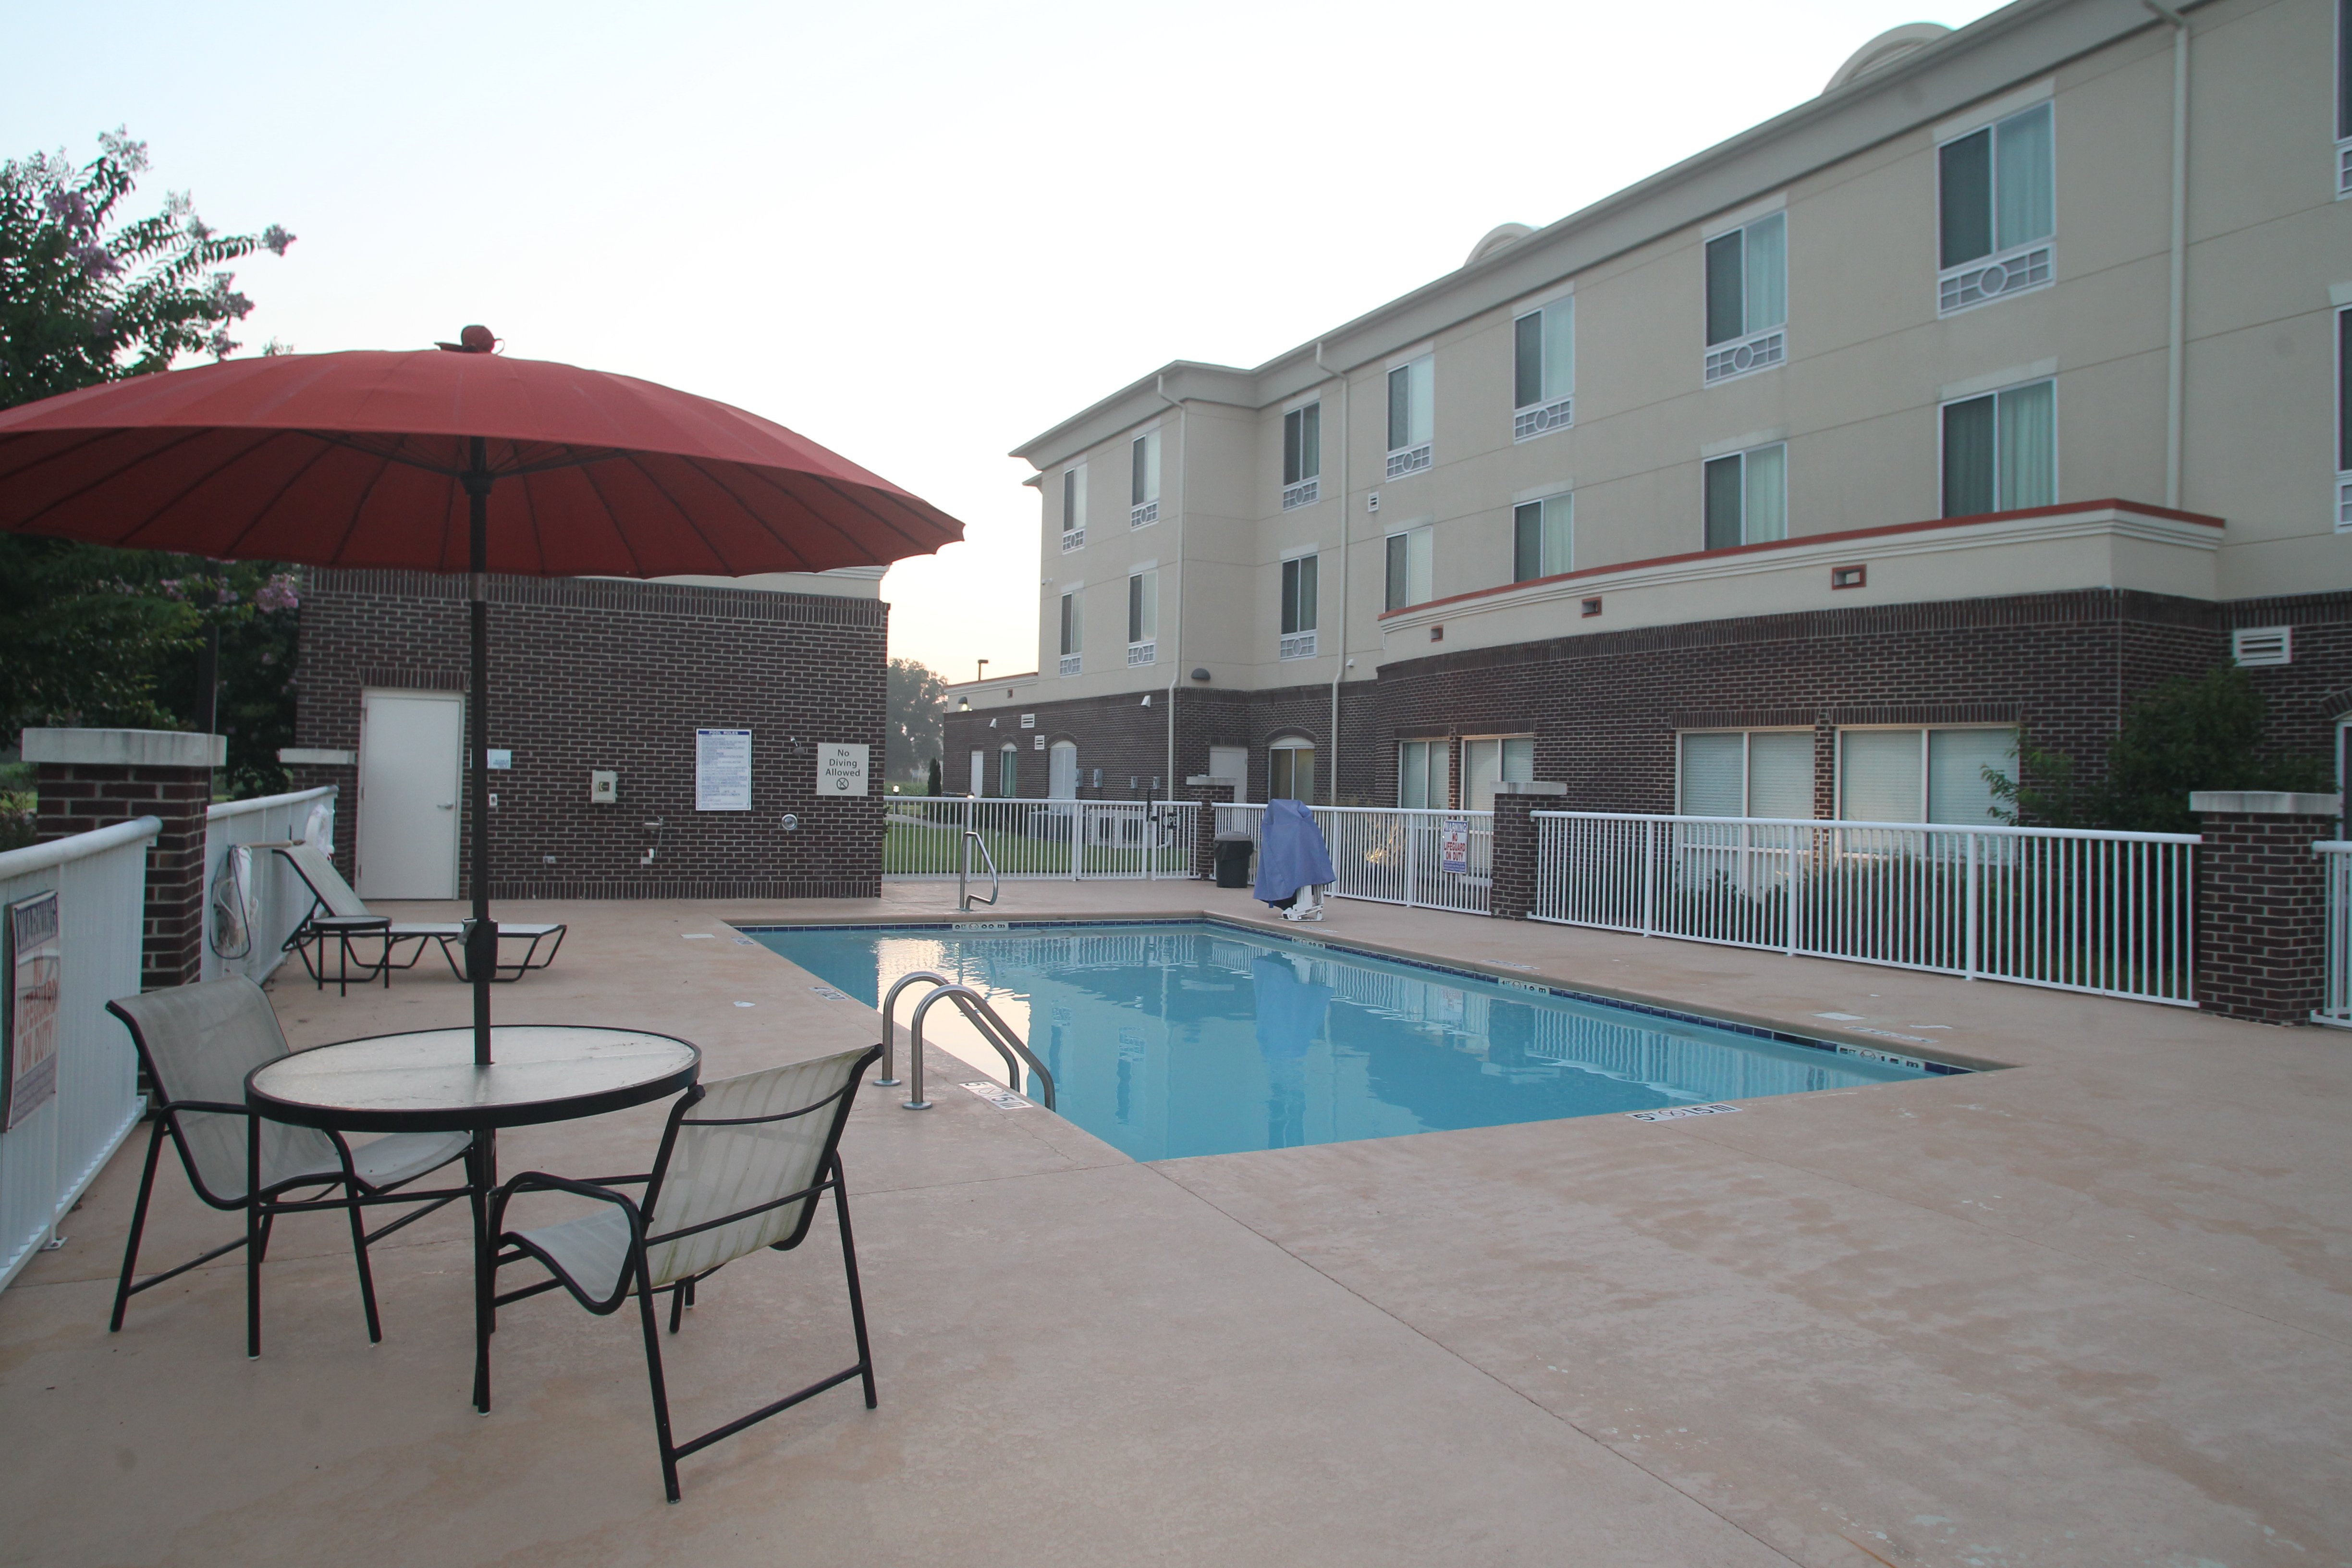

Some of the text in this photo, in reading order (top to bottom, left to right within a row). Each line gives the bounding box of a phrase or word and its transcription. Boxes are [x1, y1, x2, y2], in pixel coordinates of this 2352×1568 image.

[829, 759, 857, 769] Diving
[825, 768, 860, 776] Allowed
[1163, 816, 1180, 826] OPE
[1444, 822, 1467, 832] WARNING
[1452, 833, 1458, 842] NO
[1444, 841, 1466, 852] LIFEGUARD
[1446, 851, 1464, 861] ON DUTY
[17, 897, 57, 953] WARNING
[18, 978, 57, 1037] LIFEGUARD
[22, 1017, 53, 1074] ON DUTY
